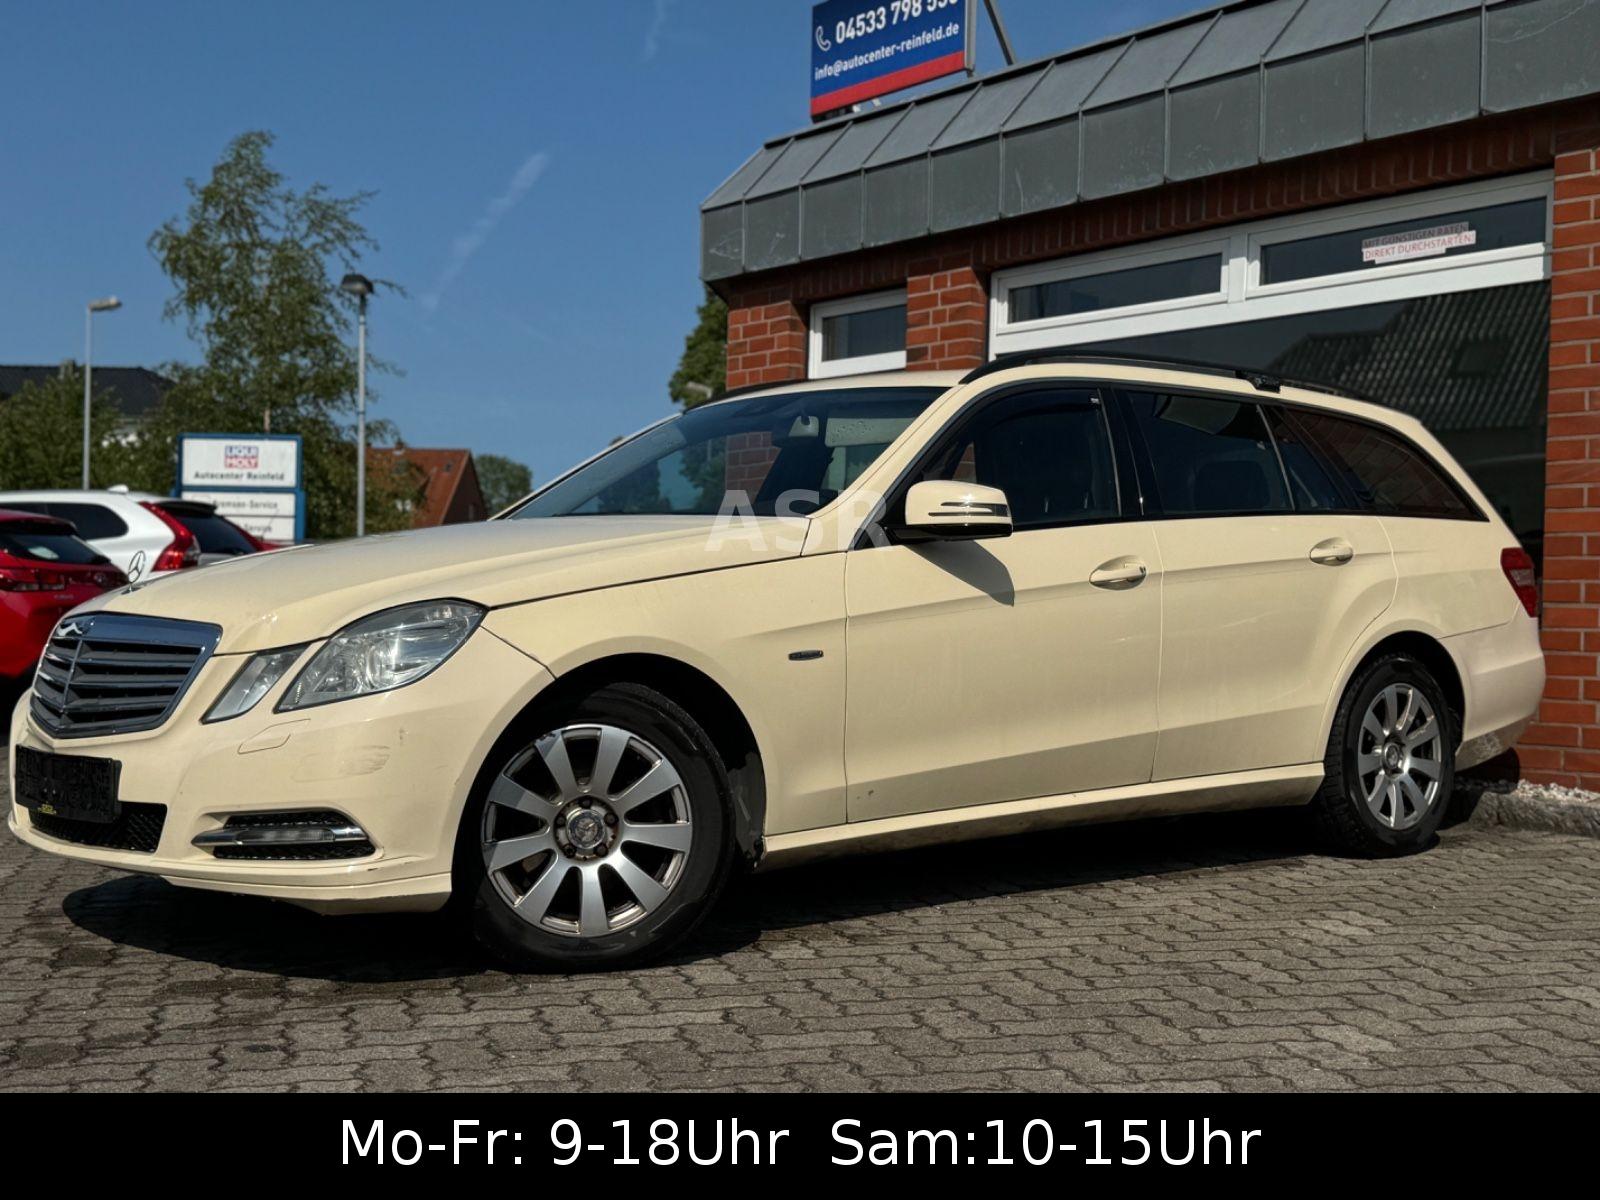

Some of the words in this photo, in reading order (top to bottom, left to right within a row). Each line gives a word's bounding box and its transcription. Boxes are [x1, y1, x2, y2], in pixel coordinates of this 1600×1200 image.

[835, 7, 887, 44] 04533
[890, 0, 922, 25] 798
[814, 22, 960, 81] info@autocenter-reinfeld.de
[1365, 246, 1396, 260] DIREKT
[193, 471, 243, 480] Autocenter
[246, 471, 285, 480] Reinfeld
